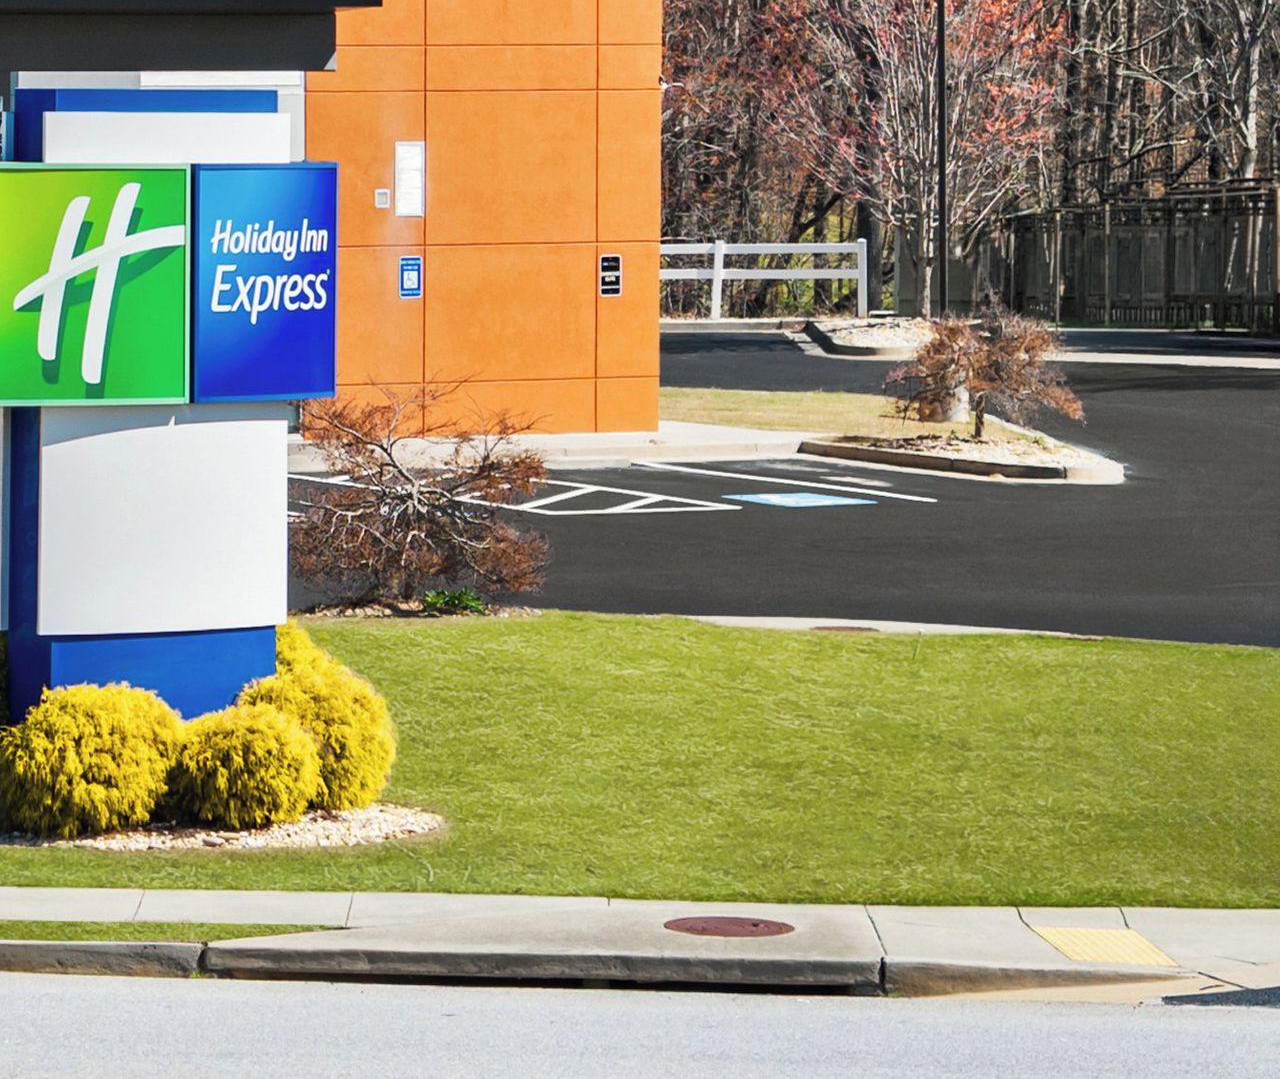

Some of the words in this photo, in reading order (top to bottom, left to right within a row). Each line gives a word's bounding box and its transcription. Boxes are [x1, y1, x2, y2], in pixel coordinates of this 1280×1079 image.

[210, 219, 299, 261] Holiday
[300, 218, 328, 252] Inn
[211, 264, 328, 325] Express
